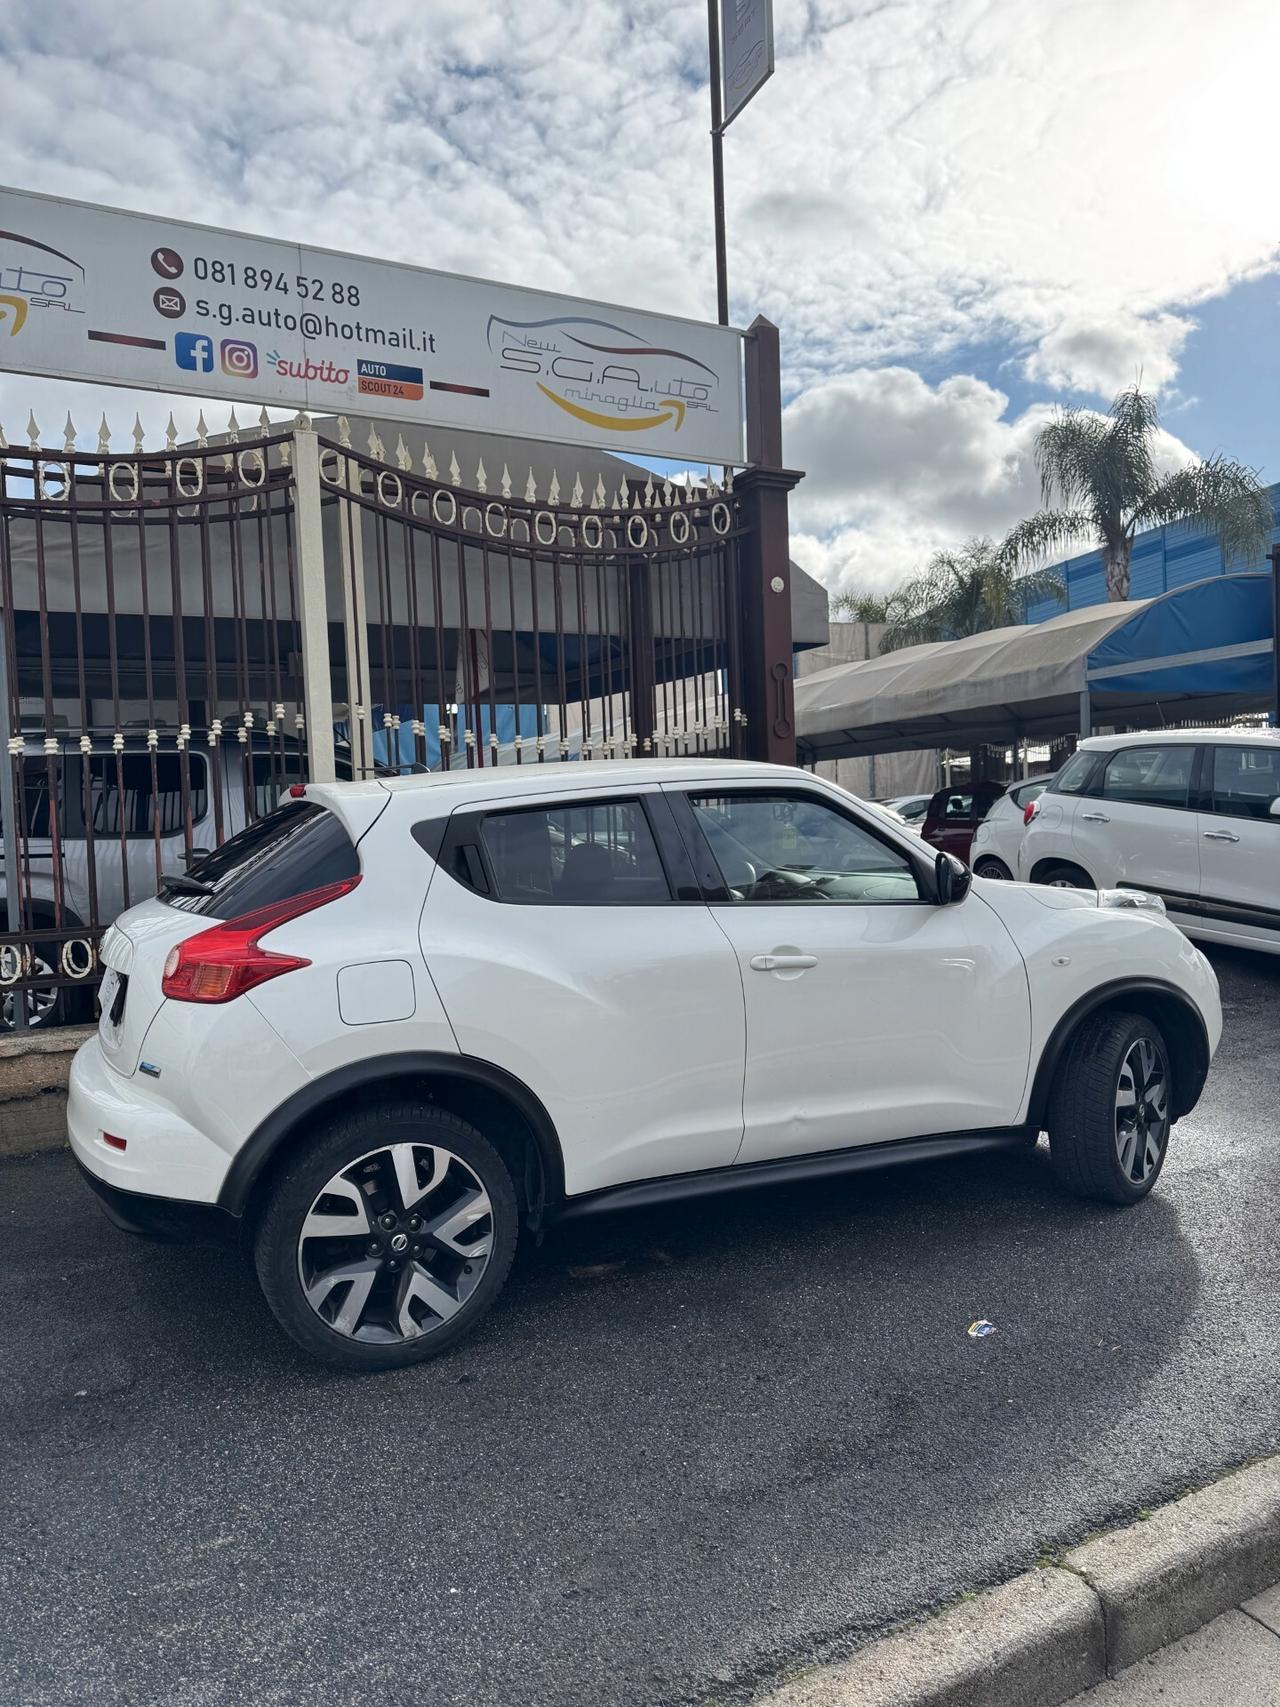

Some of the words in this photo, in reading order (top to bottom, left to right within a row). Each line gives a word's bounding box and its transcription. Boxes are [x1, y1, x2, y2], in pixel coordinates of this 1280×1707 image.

[194, 257, 236, 285] 081
[244, 266, 289, 295] 894
[296, 276, 324, 302] 52
[331, 283, 361, 307] 88
[29, 297, 86, 313] SRL
[196, 299, 436, 353] s.g.auto@hotmail.it
[502, 330, 561, 353] New
[276, 358, 350, 385] subito
[361, 362, 387, 376] AUTO
